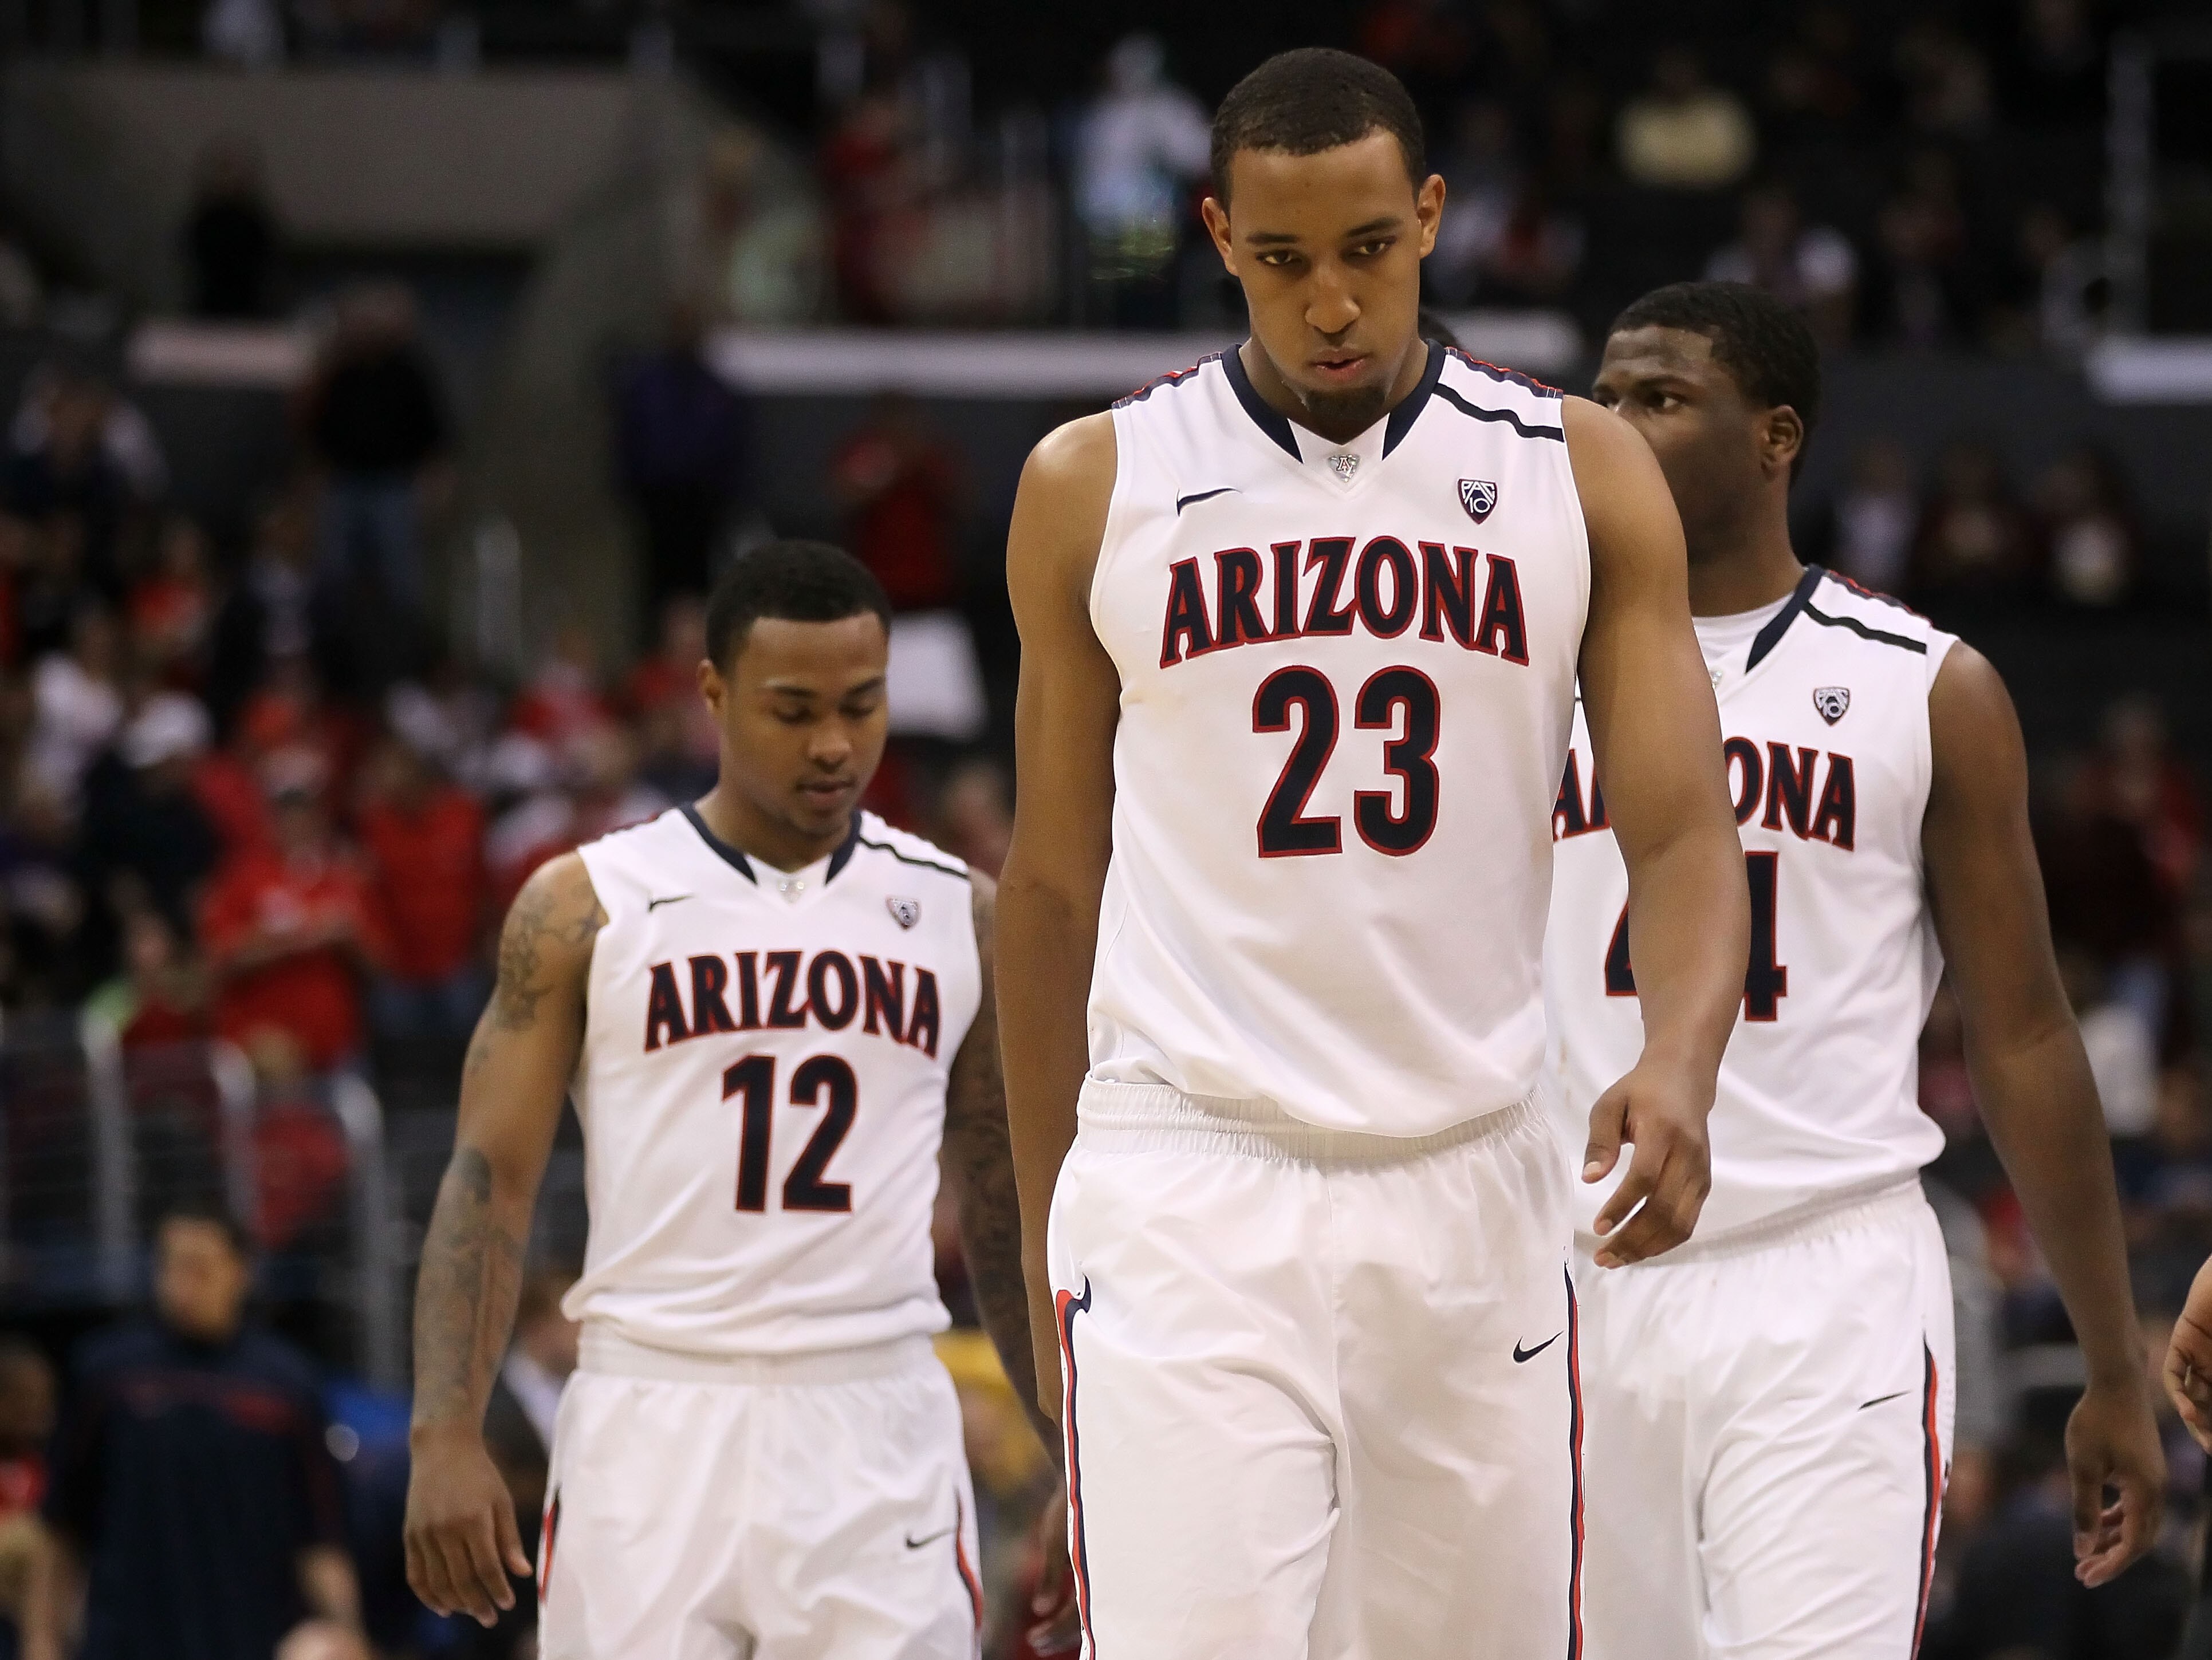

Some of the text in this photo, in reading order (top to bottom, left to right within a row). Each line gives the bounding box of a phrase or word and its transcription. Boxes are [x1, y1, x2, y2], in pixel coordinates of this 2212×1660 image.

[1461, 480, 1495, 505] PAC
[1469, 496, 1491, 513] 10
[1160, 535, 1530, 669] ARIZONA
[1252, 665, 1441, 858] 23
[644, 949, 940, 1061] ARIZONA
[722, 1054, 858, 1212] 12
